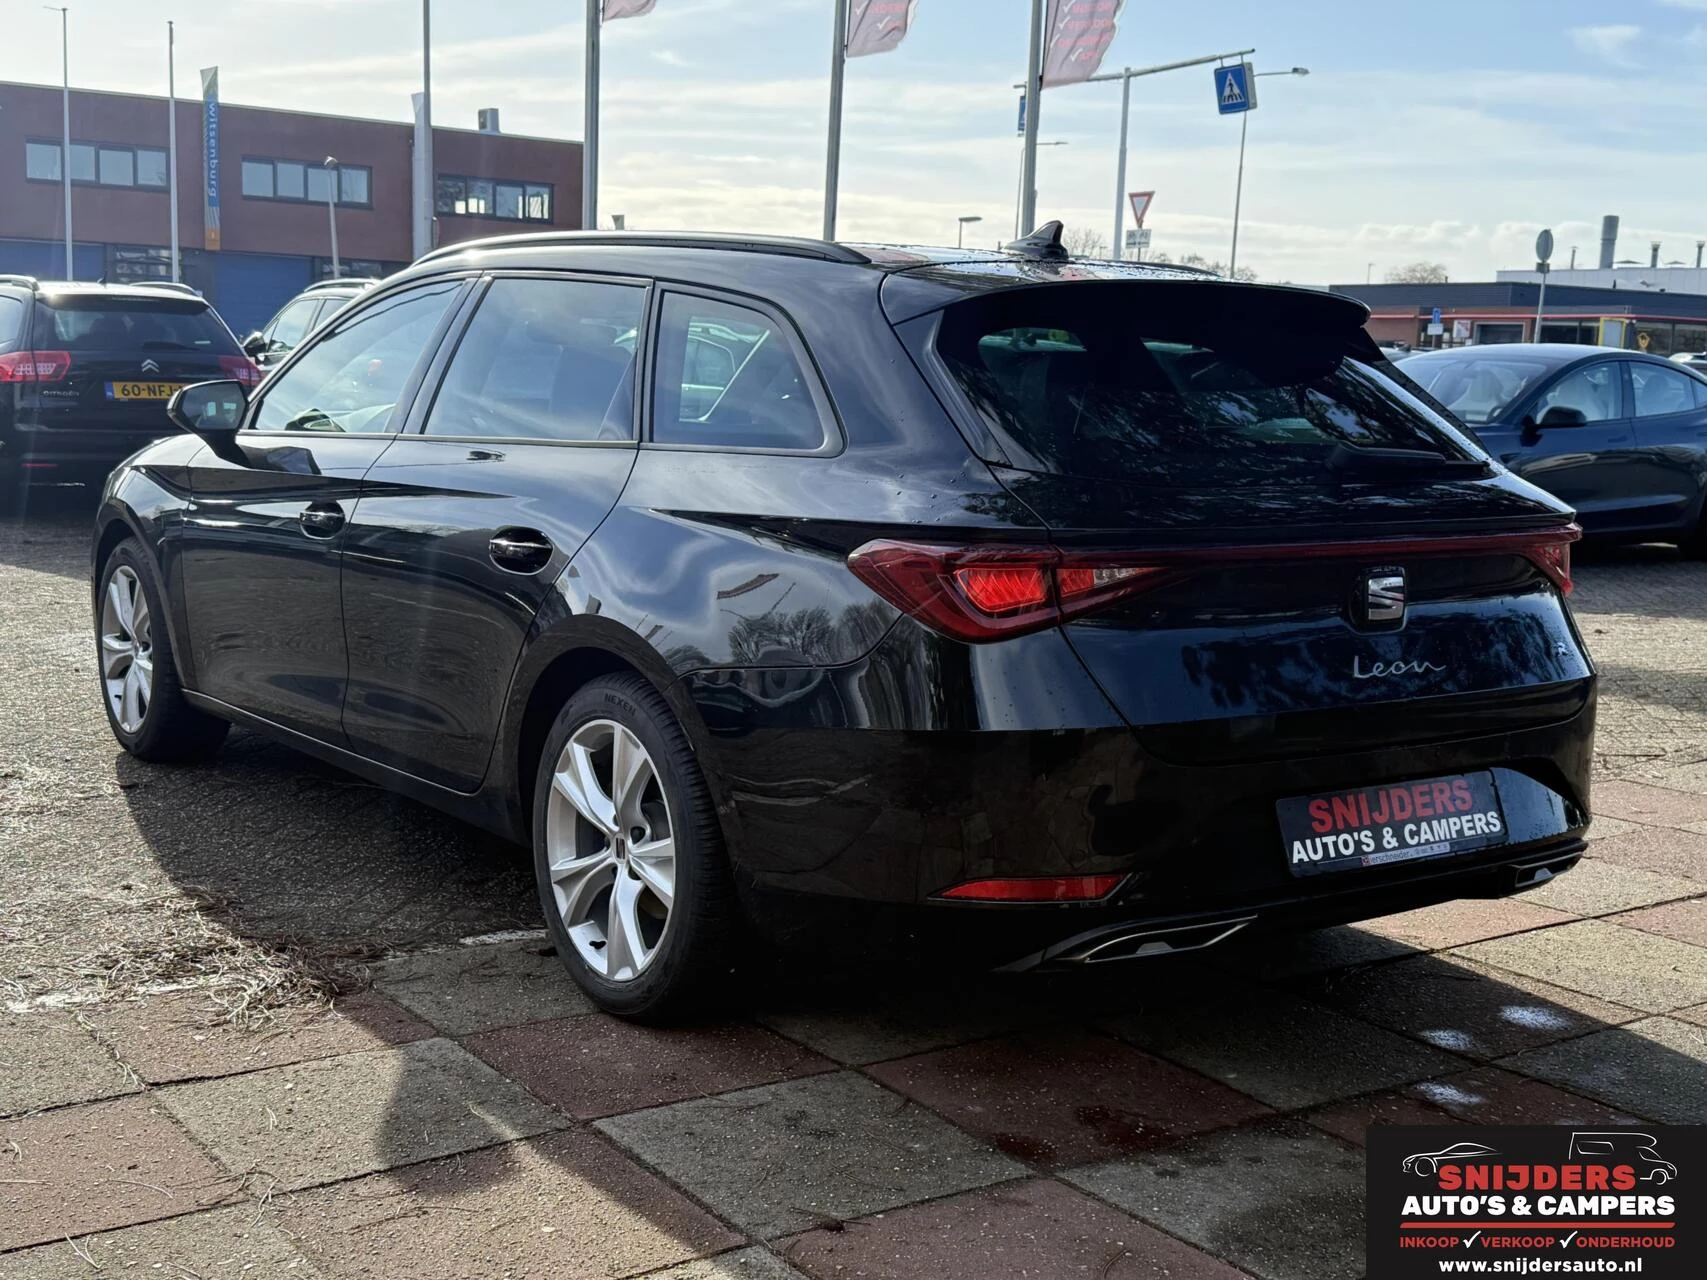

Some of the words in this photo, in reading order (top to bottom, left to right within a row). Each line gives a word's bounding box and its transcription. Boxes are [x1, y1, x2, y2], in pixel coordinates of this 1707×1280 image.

[207, 103, 218, 197] witsenburg
[121, 384, 181, 397] 60-NFJ-
[1353, 655, 1447, 678] Leon
[604, 693, 636, 716] NEXEN
[1309, 780, 1473, 832] SNIJDERS
[1292, 830, 1375, 864] AUTO'S
[1382, 826, 1399, 850] &
[1404, 811, 1501, 846] CAMPERS
